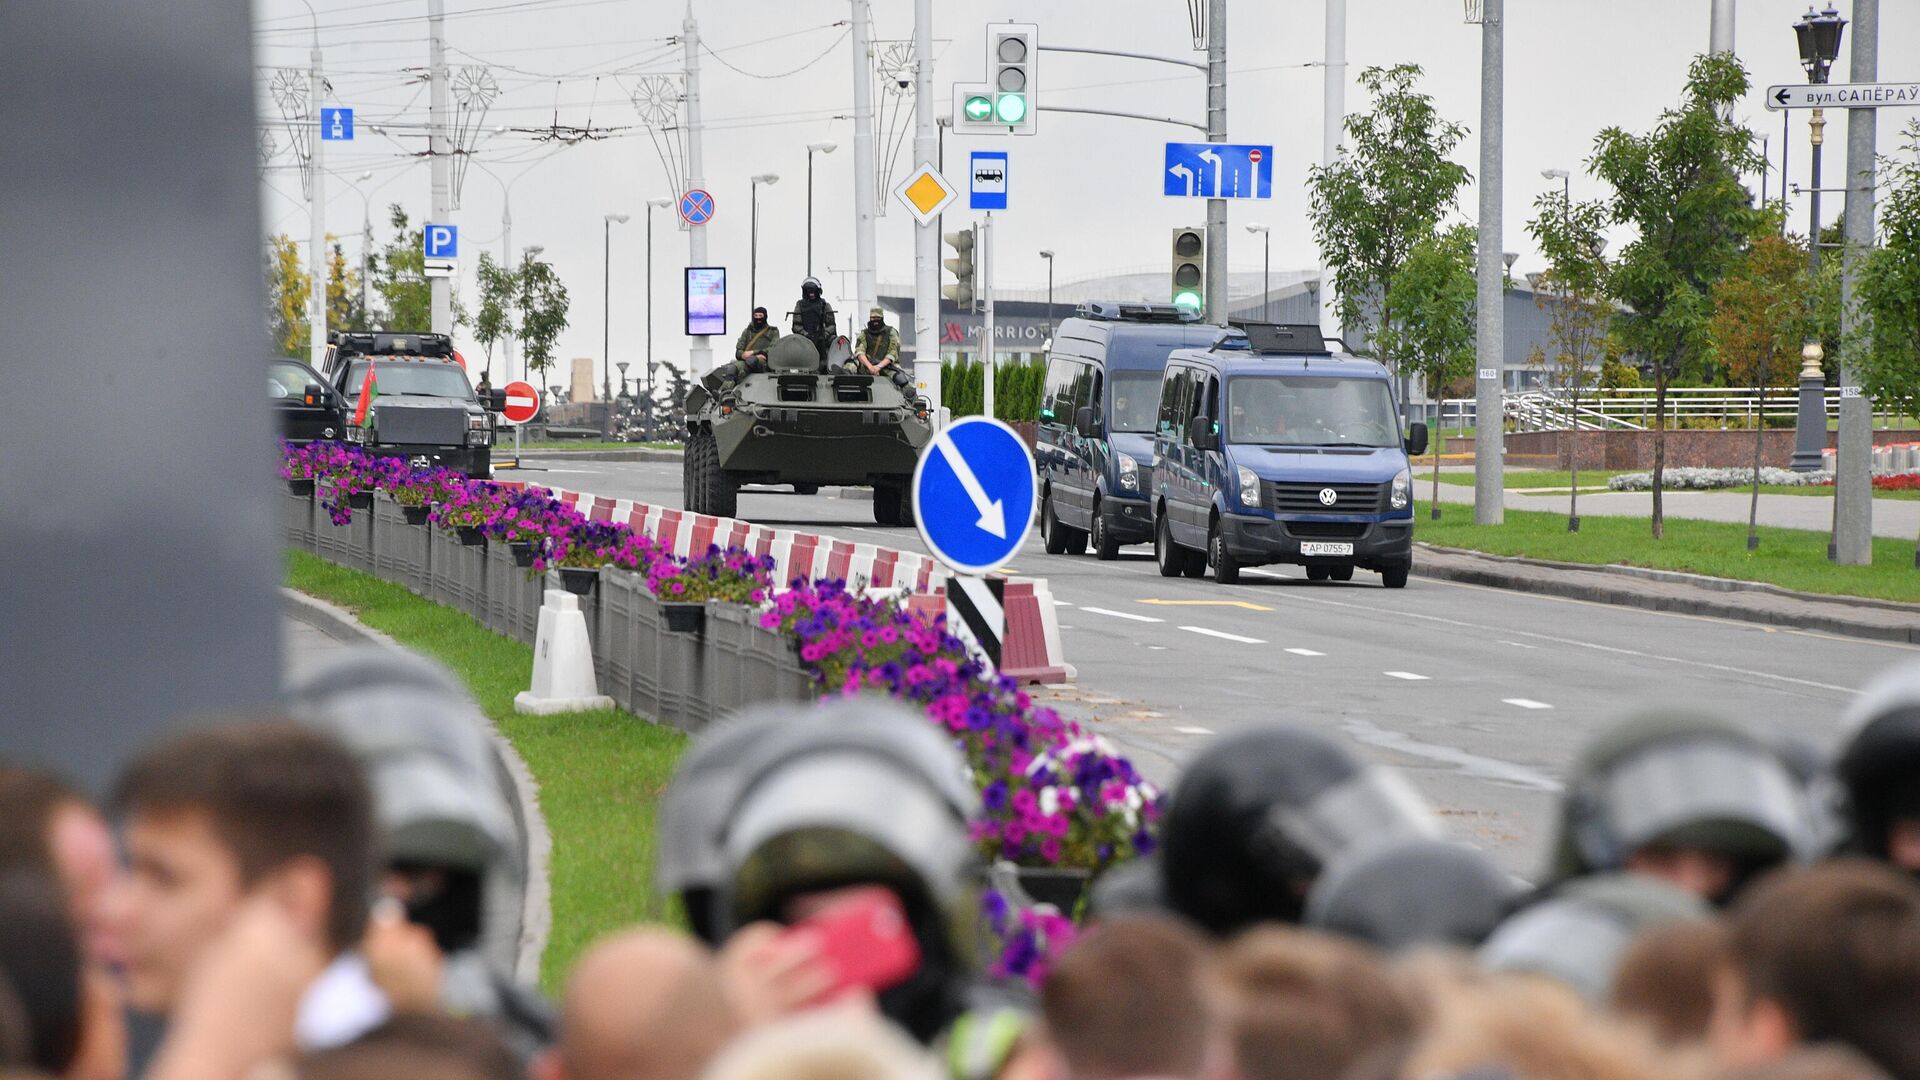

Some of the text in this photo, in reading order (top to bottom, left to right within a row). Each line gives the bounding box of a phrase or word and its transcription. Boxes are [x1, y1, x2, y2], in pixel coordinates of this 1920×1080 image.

[1807, 85, 1919, 105] вул. САПЁРАЎ
[432, 227, 452, 255] P
[967, 326, 1058, 338] MRRIOT
[1845, 388, 1859, 396] 158
[1323, 544, 1351, 553] 0755-7
